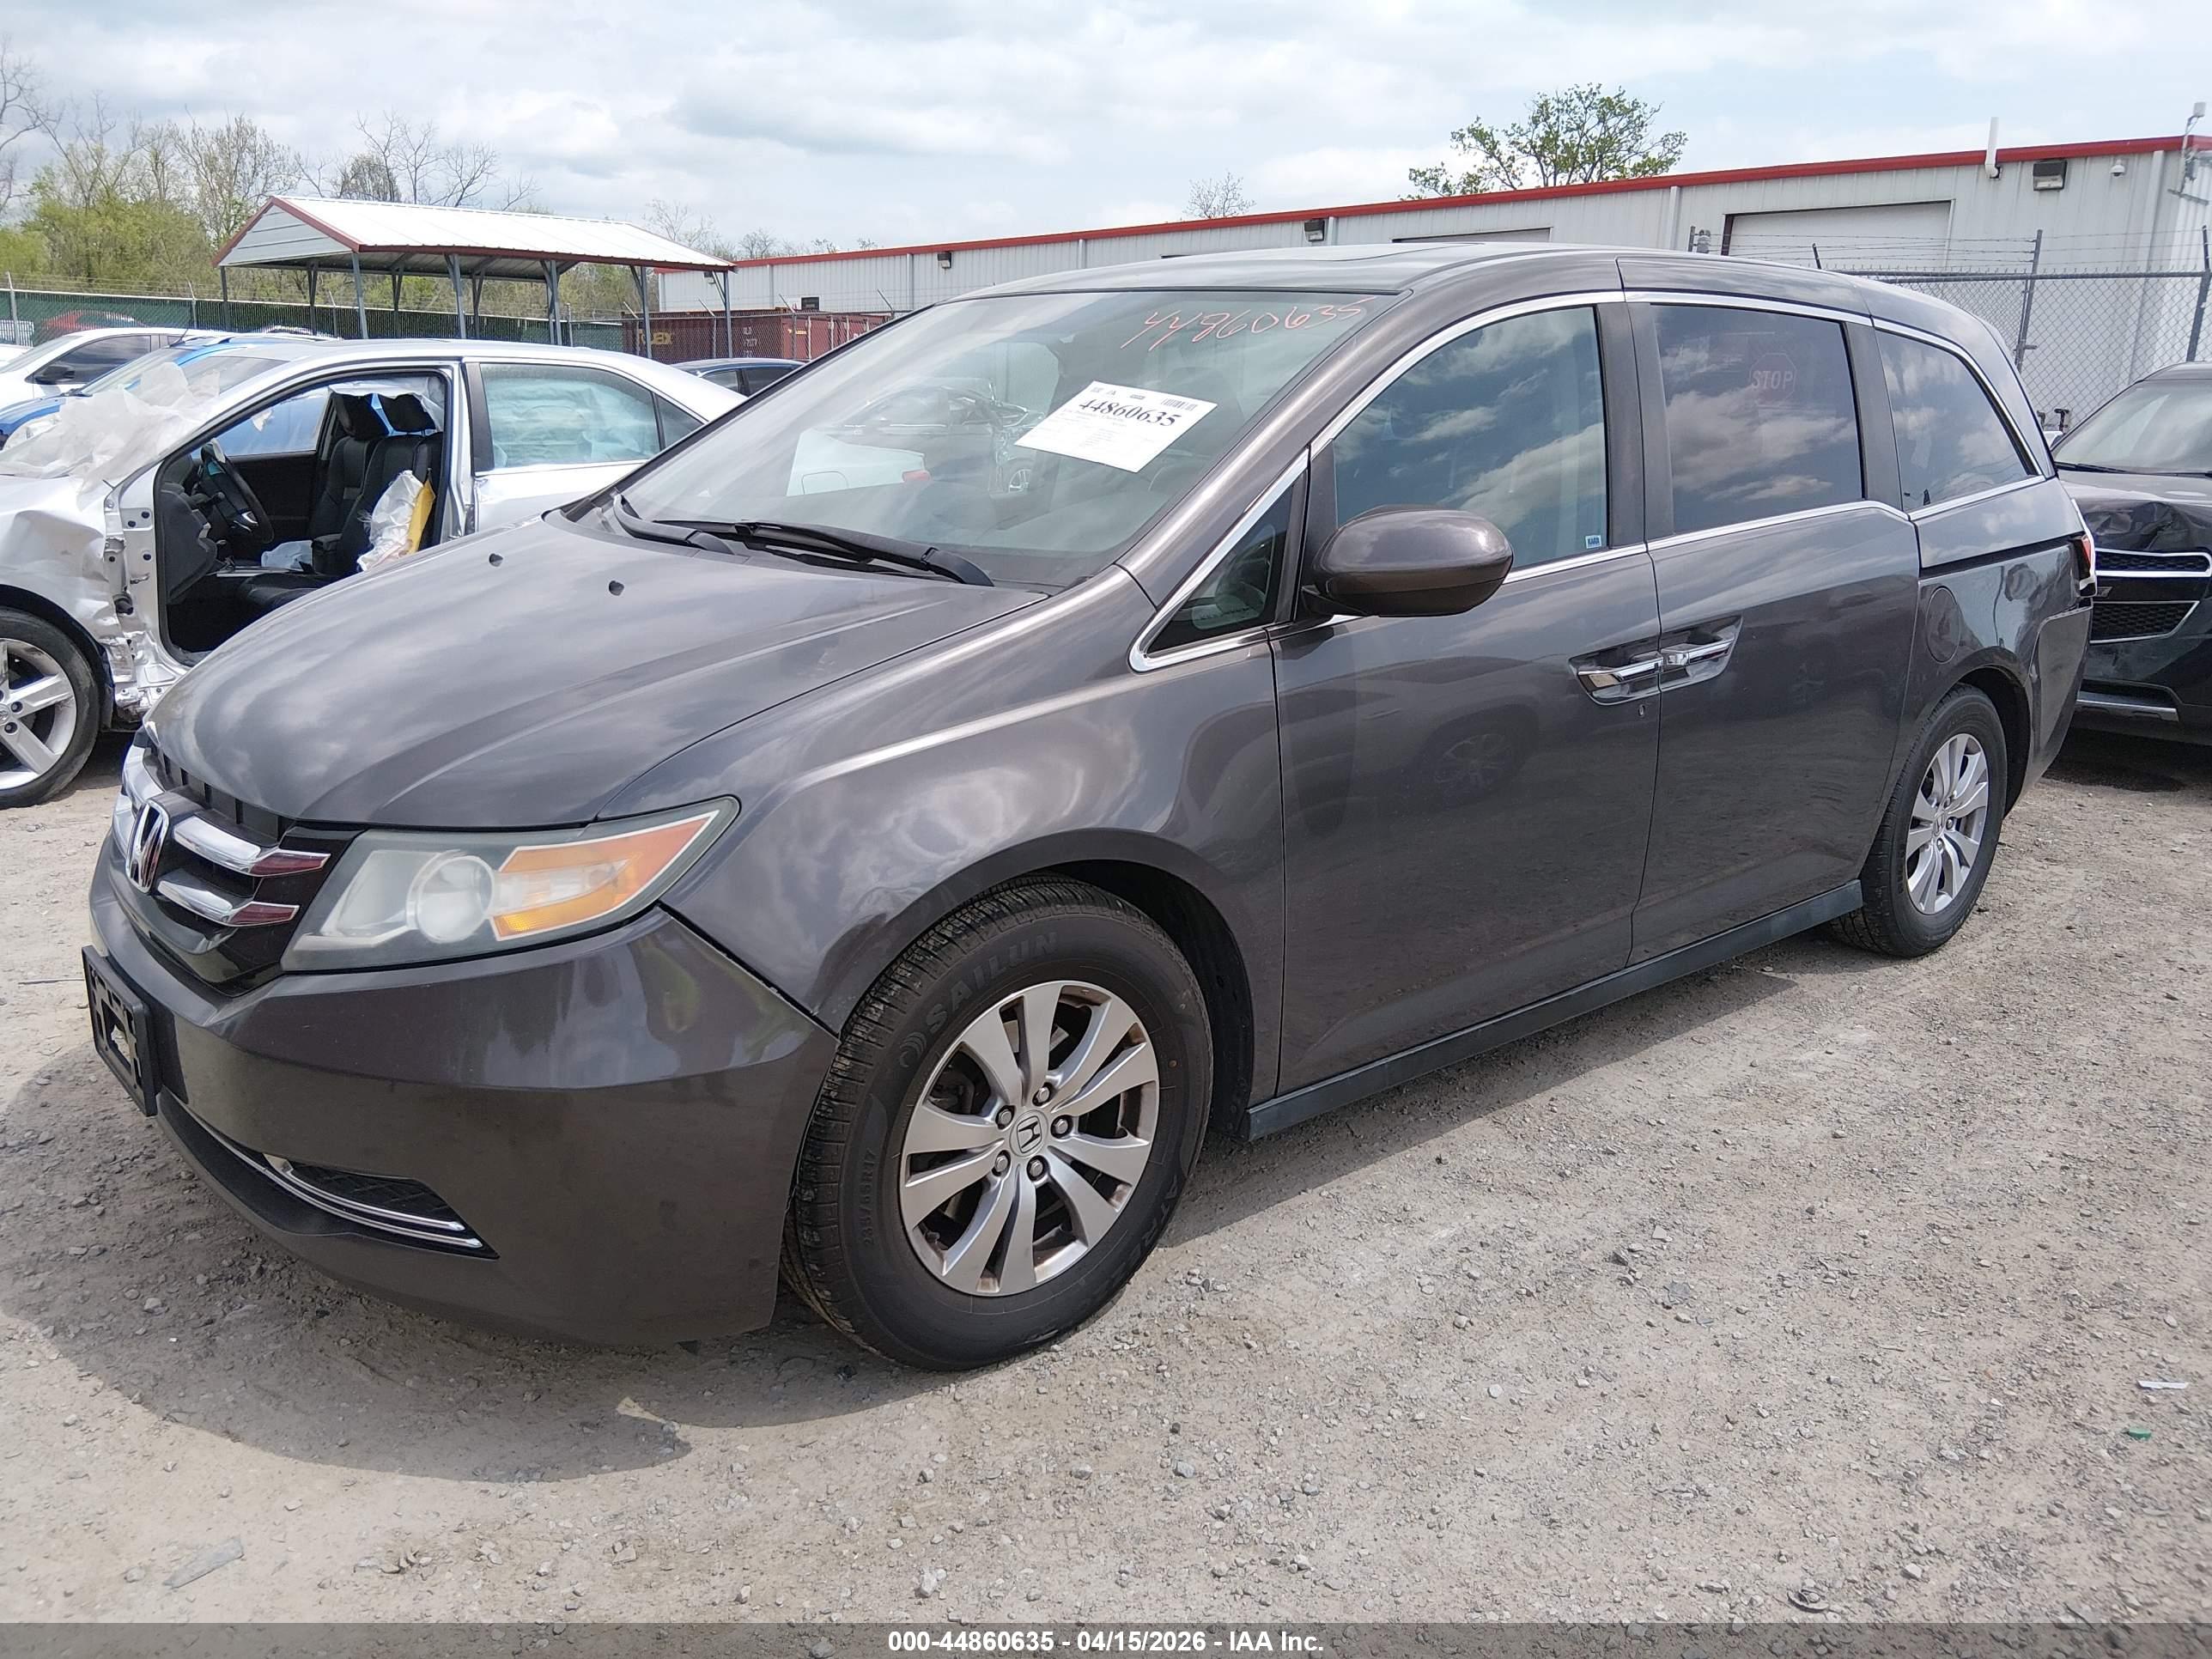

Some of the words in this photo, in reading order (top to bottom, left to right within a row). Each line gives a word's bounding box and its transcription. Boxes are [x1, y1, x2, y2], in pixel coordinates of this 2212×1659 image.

[1121, 295, 1375, 352] 44860635
[1751, 370, 1794, 390] STOP
[1079, 398, 1182, 427] 44860635
[926, 931, 1059, 1035] SAILUN
